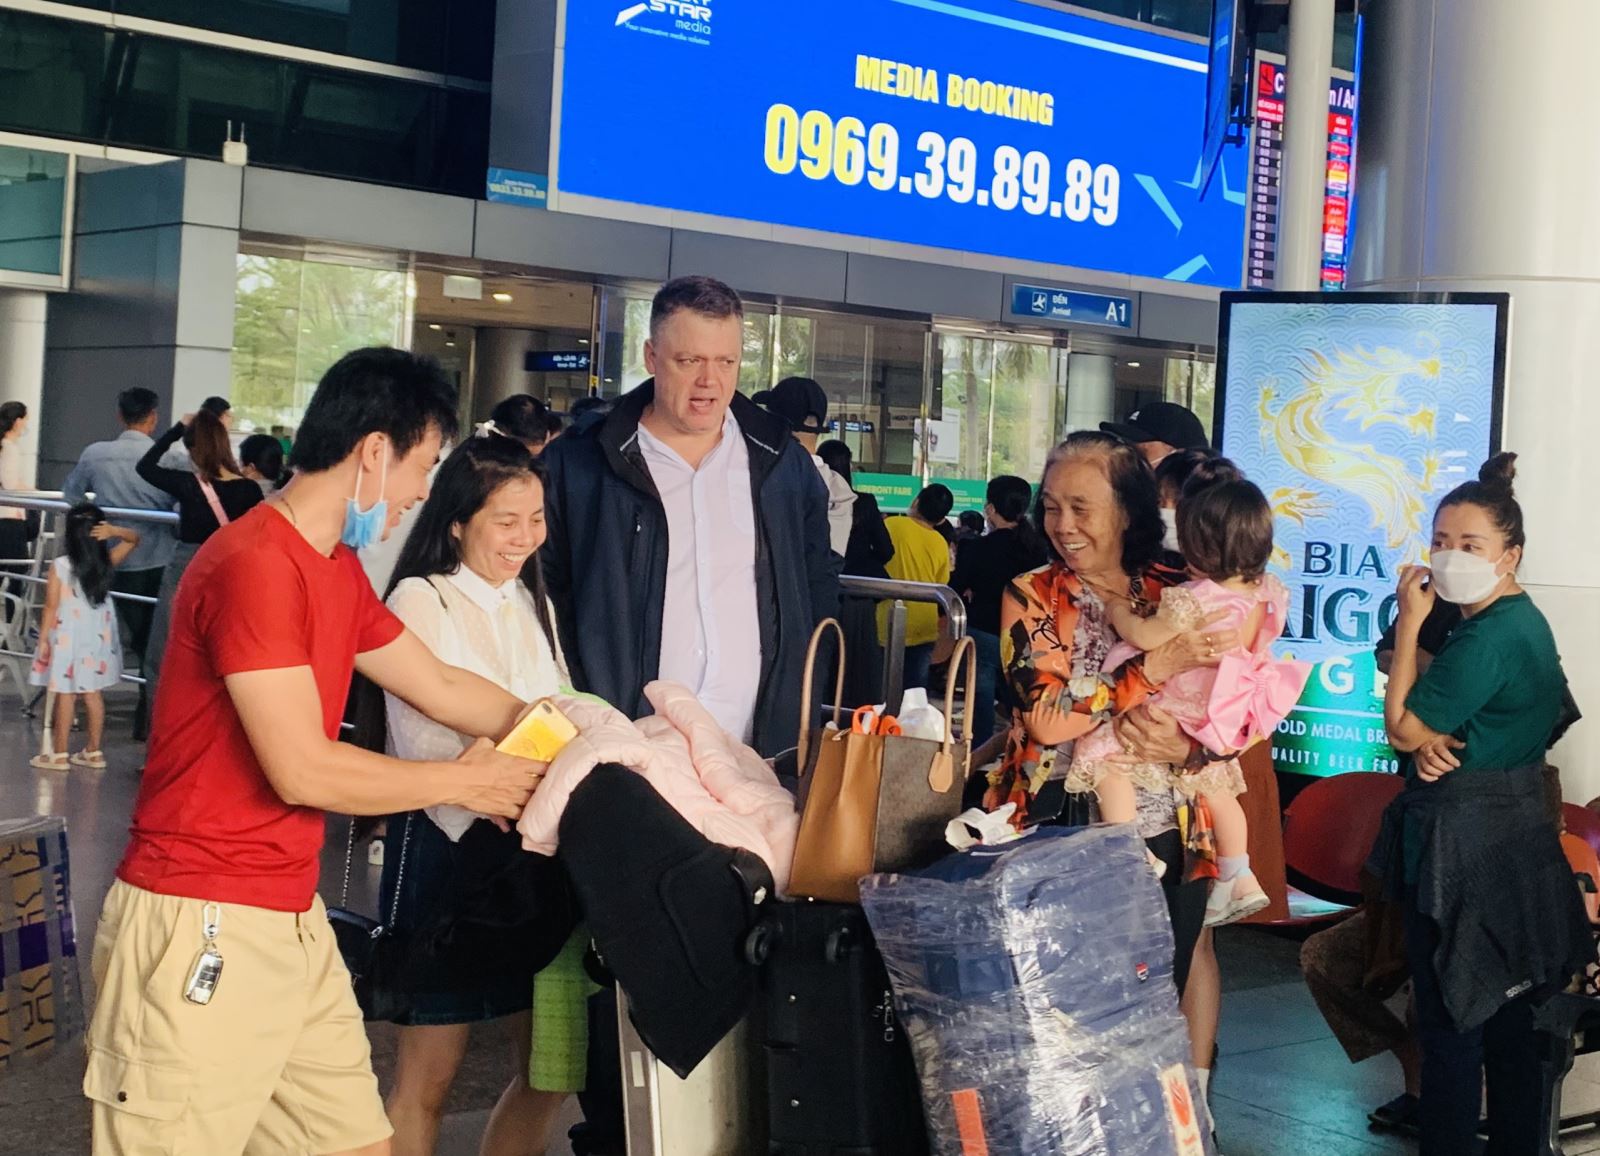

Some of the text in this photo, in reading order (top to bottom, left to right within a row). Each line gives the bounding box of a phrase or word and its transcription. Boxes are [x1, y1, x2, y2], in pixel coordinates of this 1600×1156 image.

[649, 0, 712, 22] STAR
[675, 19, 711, 35] media
[855, 54, 1055, 127] MEDIA BOOKING
[764, 103, 1121, 226] 0969.39.89.89
[1105, 301, 1126, 322] A1
[1303, 541, 1389, 581] BIA
[1273, 719, 1307, 736] OLD
[1311, 723, 1362, 742] MEDAL
[1271, 747, 1320, 766] UALITY
[1373, 758, 1399, 774] FRO
